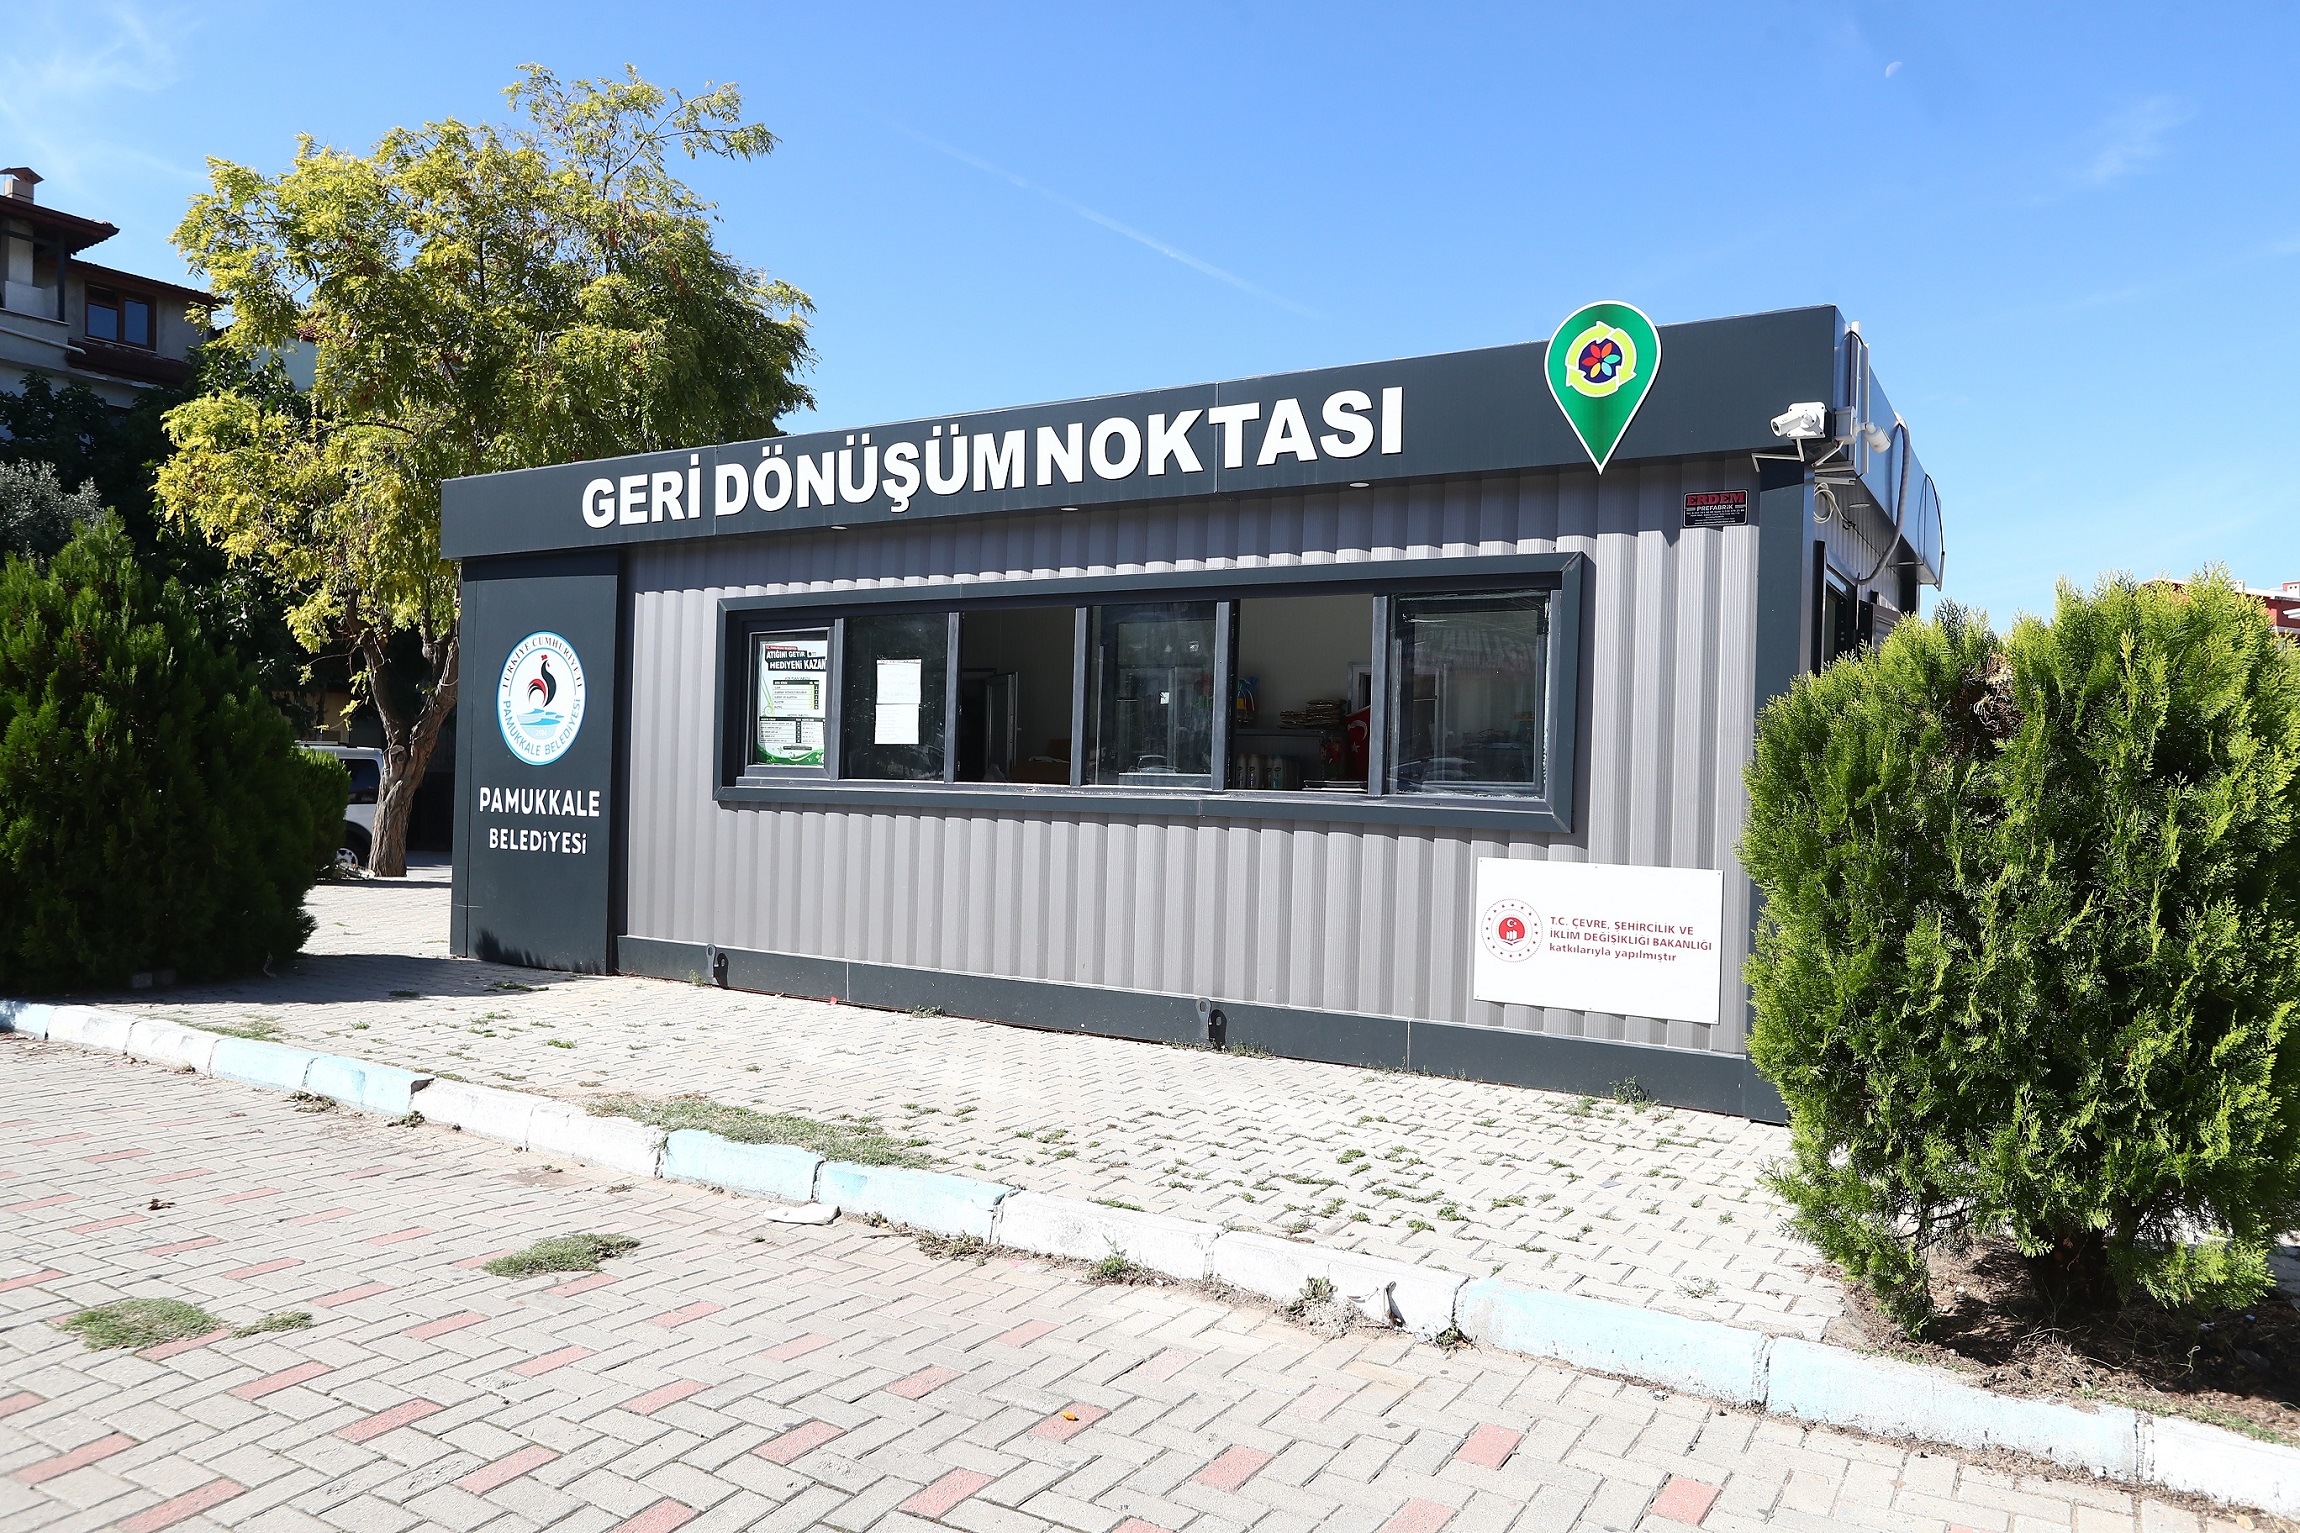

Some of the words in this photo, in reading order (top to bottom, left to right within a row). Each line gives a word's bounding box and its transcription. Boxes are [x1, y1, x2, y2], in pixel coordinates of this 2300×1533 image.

[583, 454, 701, 528] GERİ
[715, 424, 1027, 516] DÖNÜŞÜM
[1036, 387, 1403, 486] NOKTASI
[1687, 493, 1745, 506] ERDEM
[502, 642, 531, 688] TÜRKİYE
[502, 700, 541, 756] PAMUKKALE
[544, 699, 581, 755] BELEDİYESİ
[479, 786, 601, 818] PAMUKKALE
[489, 827, 587, 855] BELEDİYESİ
[1550, 928, 1580, 940] İKLİM
[1584, 931, 1650, 946] DEĞİŞİKLİĞİ
[1653, 938, 1712, 951] BAKANLIĞI
[1551, 916, 1568, 926] T.C.
[1572, 917, 1610, 930] ÇEVRE,
[1614, 920, 1675, 934] ŞEHİRCİLİK
[1679, 926, 1694, 936] VE
[1549, 943, 1611, 957] katkılarıyla
[1615, 949, 1677, 963] yapılmıştır
